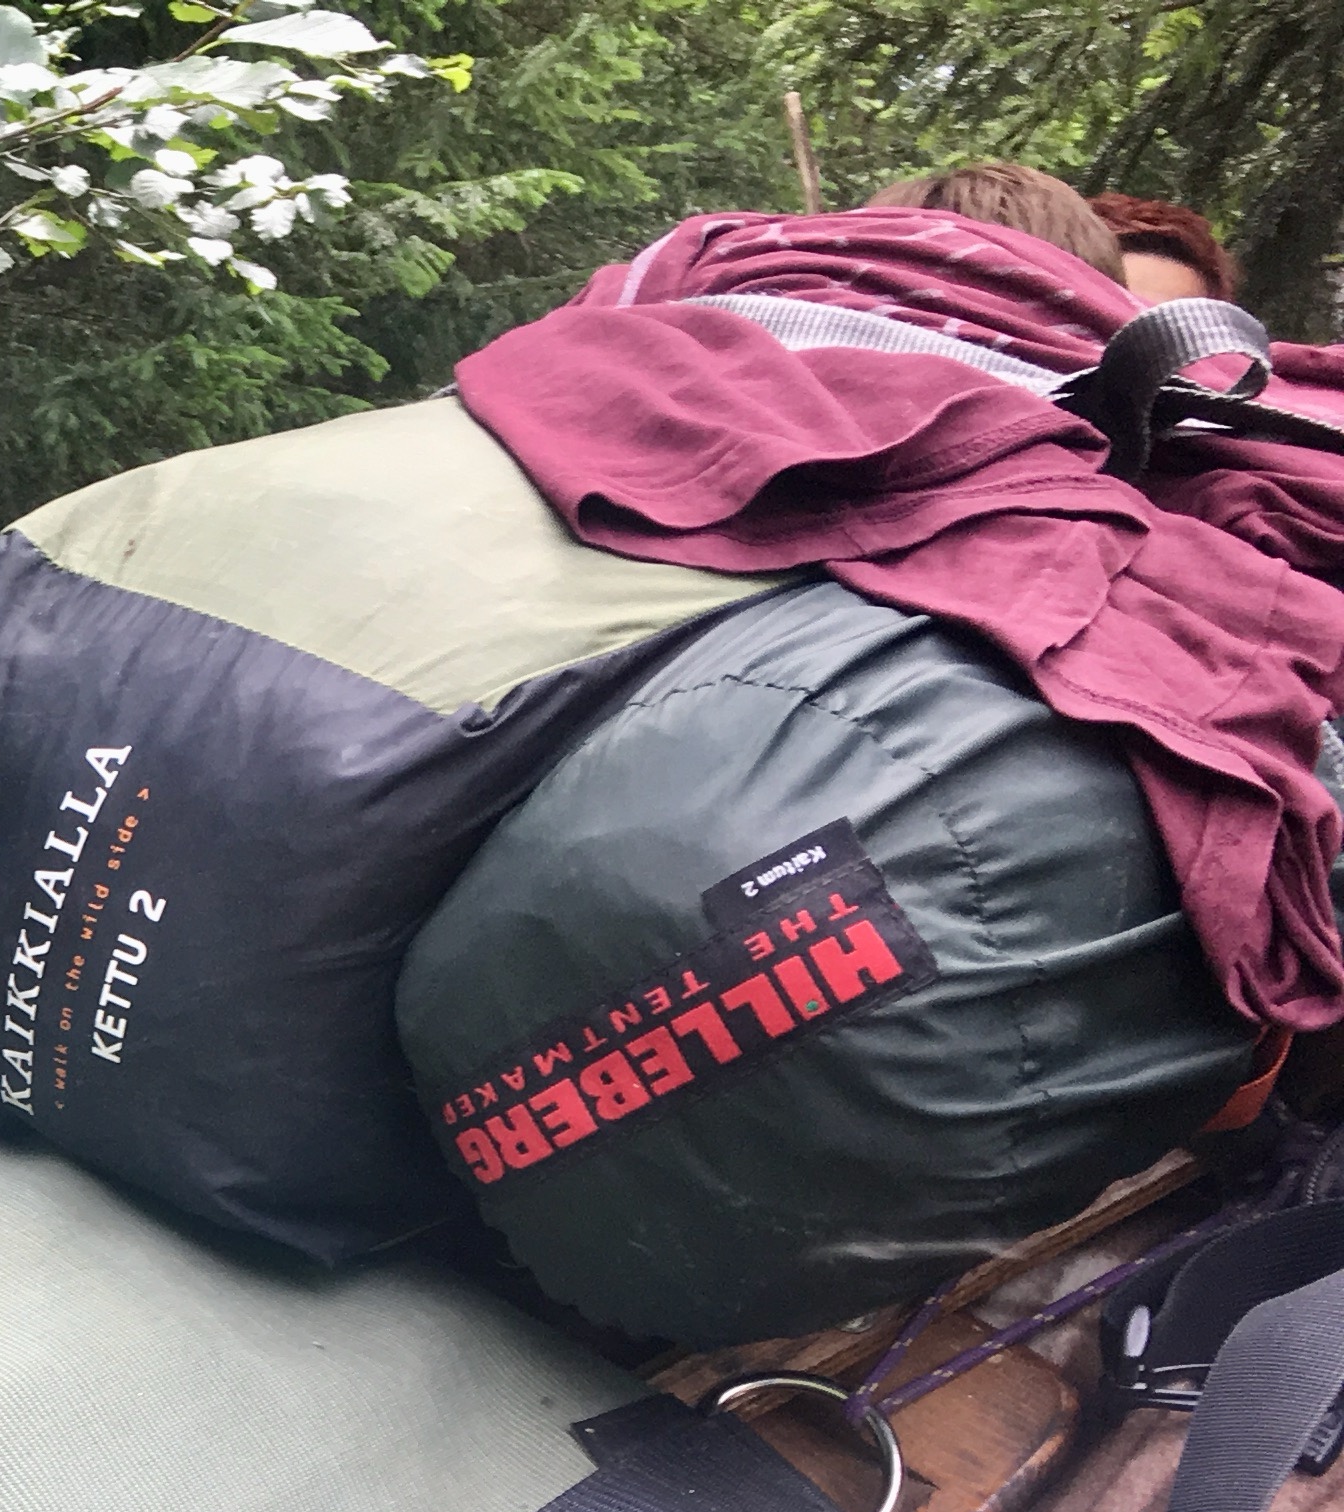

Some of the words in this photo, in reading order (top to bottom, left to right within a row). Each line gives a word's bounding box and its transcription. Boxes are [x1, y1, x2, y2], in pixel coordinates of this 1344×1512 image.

[107, 815, 140, 871] side
[756, 845, 827, 887] Kaitum
[79, 883, 110, 940] wild
[740, 880, 759, 898] 2
[0, 745, 133, 1116] KAIKKIALLA
[742, 893, 860, 962] THE
[64, 954, 86, 991] the
[91, 933, 148, 1064] KETTU
[128, 889, 167, 923] 2
[59, 1007, 74, 1031] on
[52, 1043, 69, 1090] walk
[454, 919, 905, 1185] HILLEBERG
